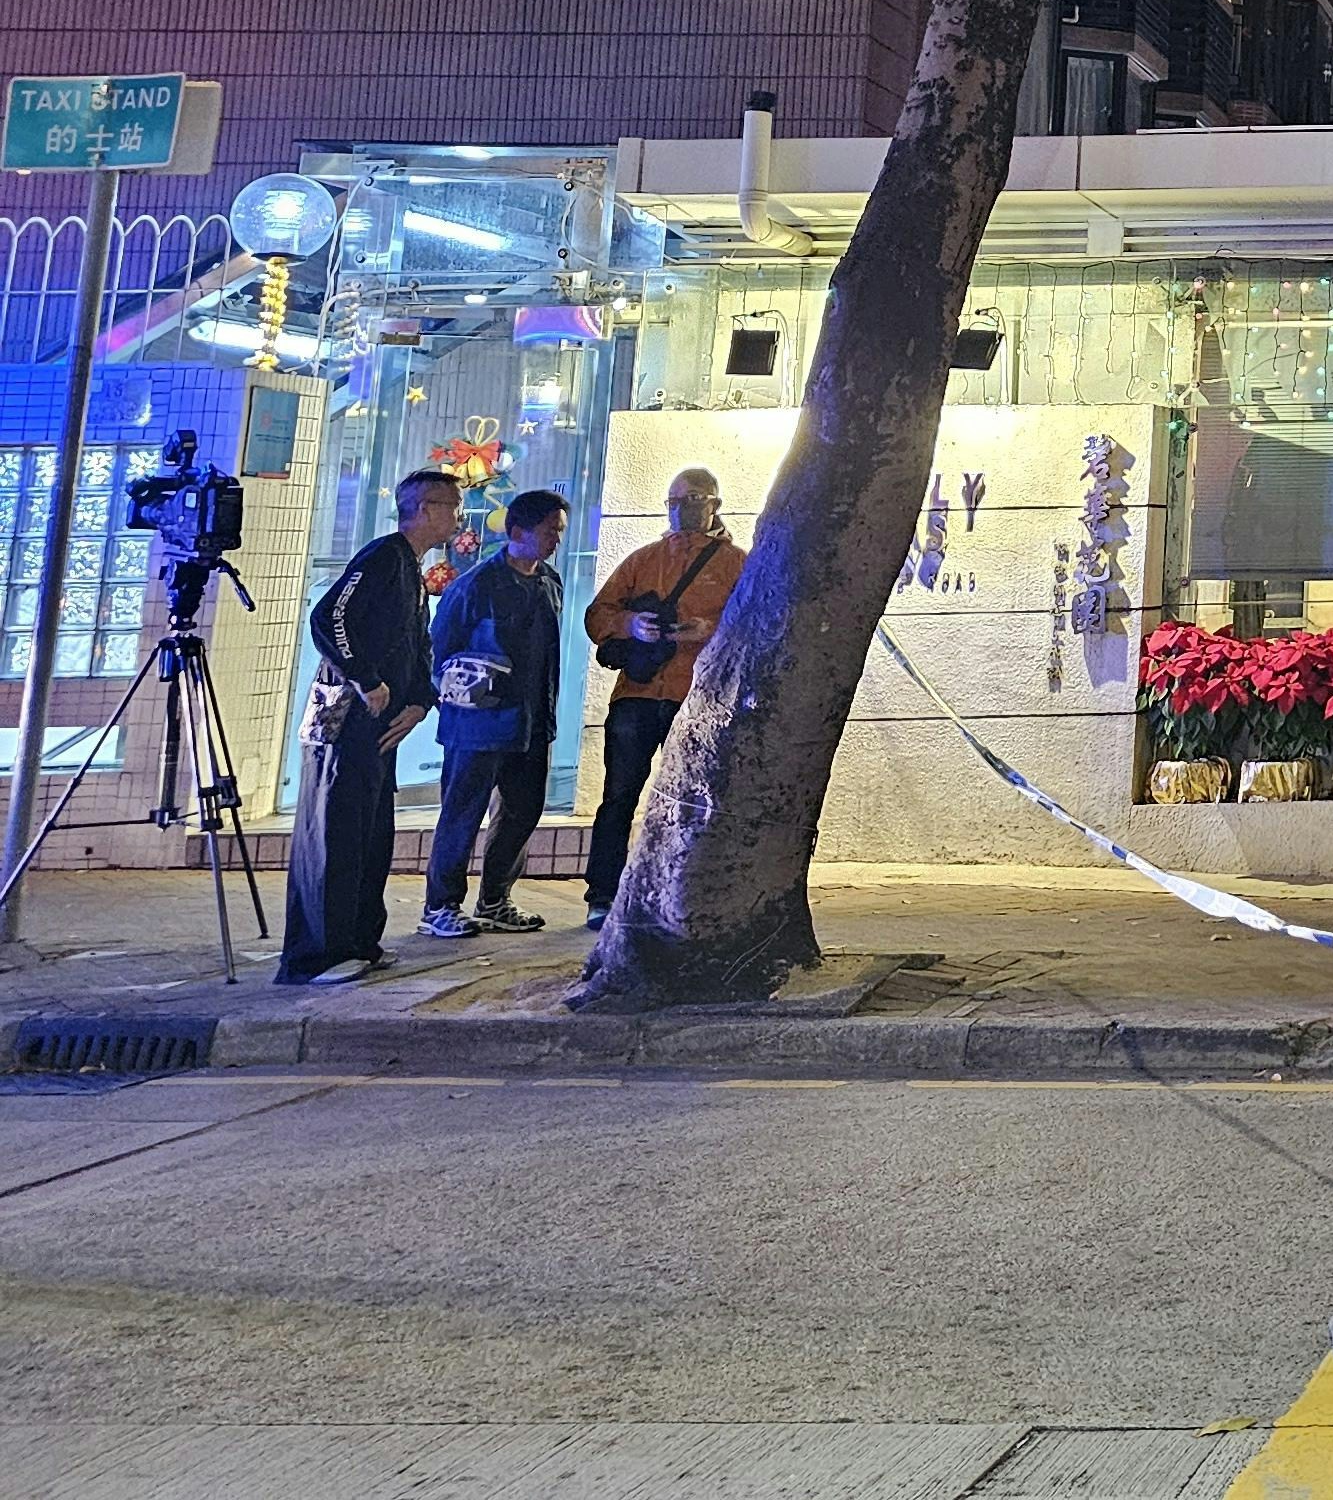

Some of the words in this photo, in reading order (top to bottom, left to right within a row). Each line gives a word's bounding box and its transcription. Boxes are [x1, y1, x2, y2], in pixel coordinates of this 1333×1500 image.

[21, 89, 82, 112] TAXI
[91, 86, 171, 111] STAND
[45, 122, 144, 154] 的士站
